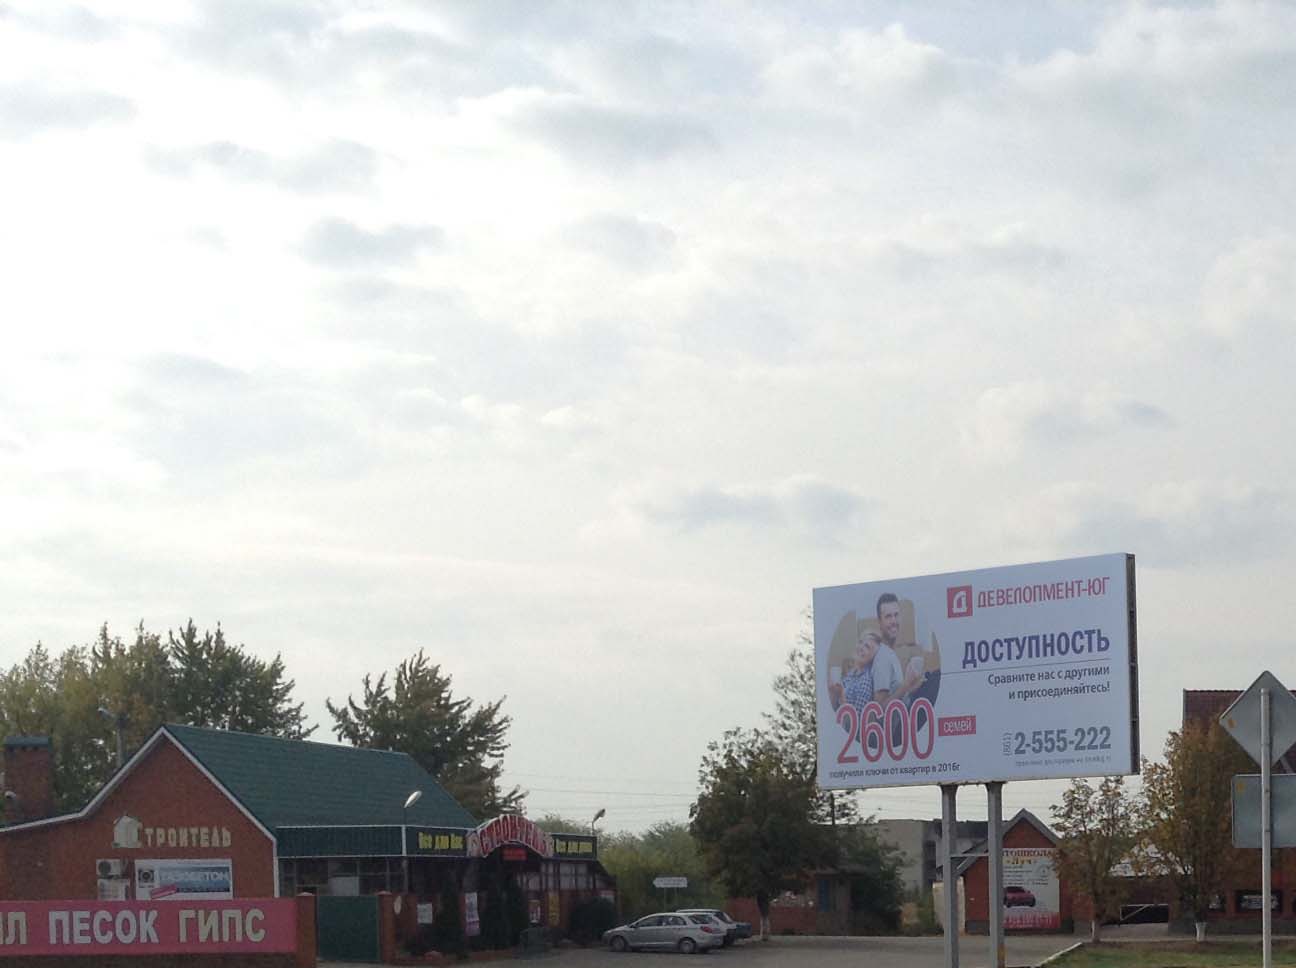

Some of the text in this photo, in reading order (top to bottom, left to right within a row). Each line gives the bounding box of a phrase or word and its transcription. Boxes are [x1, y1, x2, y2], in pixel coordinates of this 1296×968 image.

[977, 576, 1110, 609] ДЕВЕЛОПМЕНТ-ЮГ
[962, 628, 1110, 669] ДОСТУПНОСТЬ
[988, 672, 1036, 687] Сравните
[1038, 670, 1056, 681] нас
[1064, 665, 1110, 681] другими
[1008, 681, 1110, 701] и присоединяйтесь!
[836, 697, 936, 764] 2600
[1014, 726, 1112, 755] 2-555-222
[48, 909, 160, 945] ПЕСОК
[178, 909, 266, 943] ГИПС
